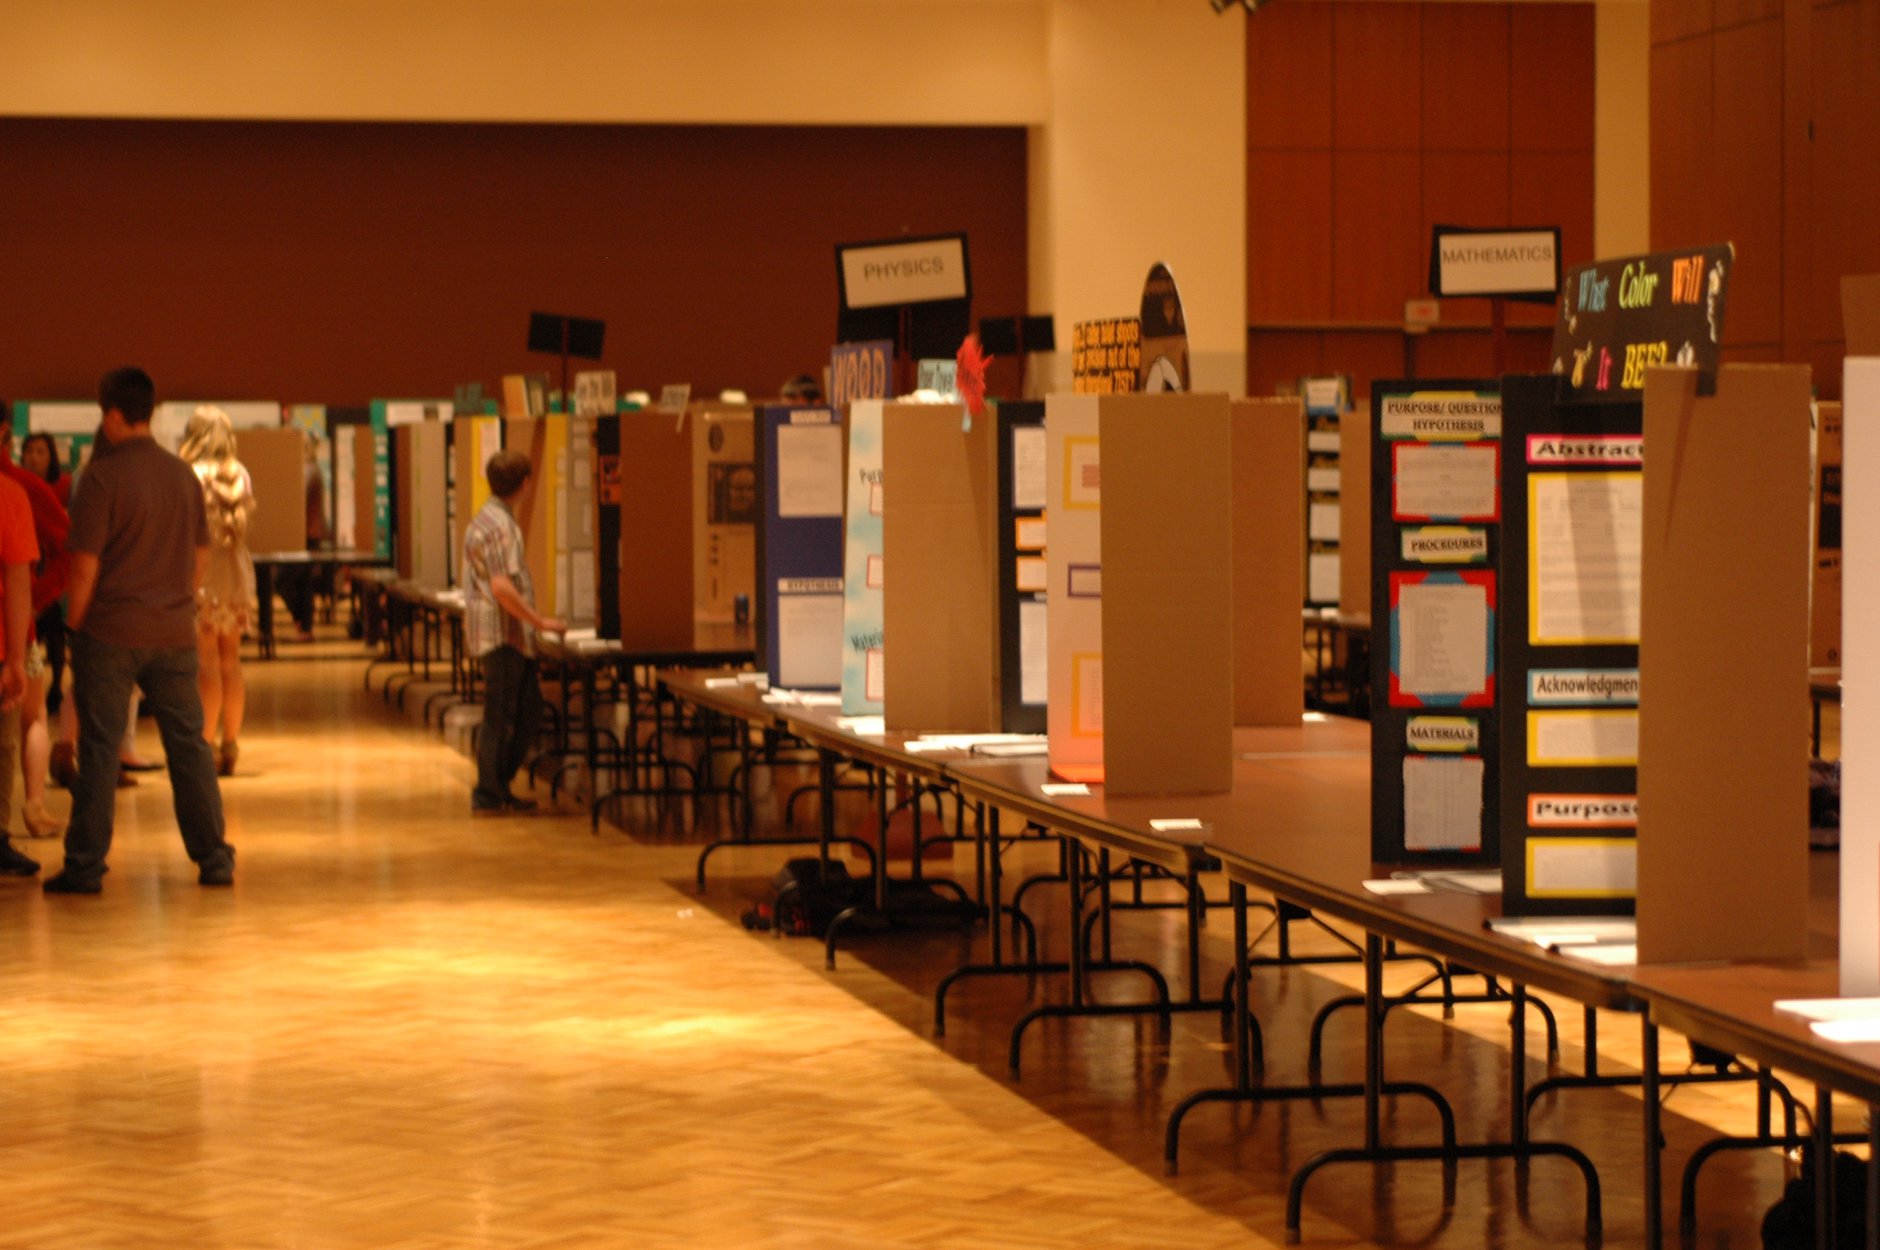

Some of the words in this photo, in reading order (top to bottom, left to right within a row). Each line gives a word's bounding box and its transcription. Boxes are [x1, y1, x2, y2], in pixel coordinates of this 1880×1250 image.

[1442, 246, 1553, 264] MATHEMATICS
[863, 256, 945, 280] PHYSICS
[1619, 261, 1658, 309] Color
[1672, 255, 1704, 304] Will
[1413, 419, 1485, 431] HYPOTHESIS
[1411, 537, 1483, 552] PROCEDURES
[1410, 726, 1475, 740] MATERIALS
